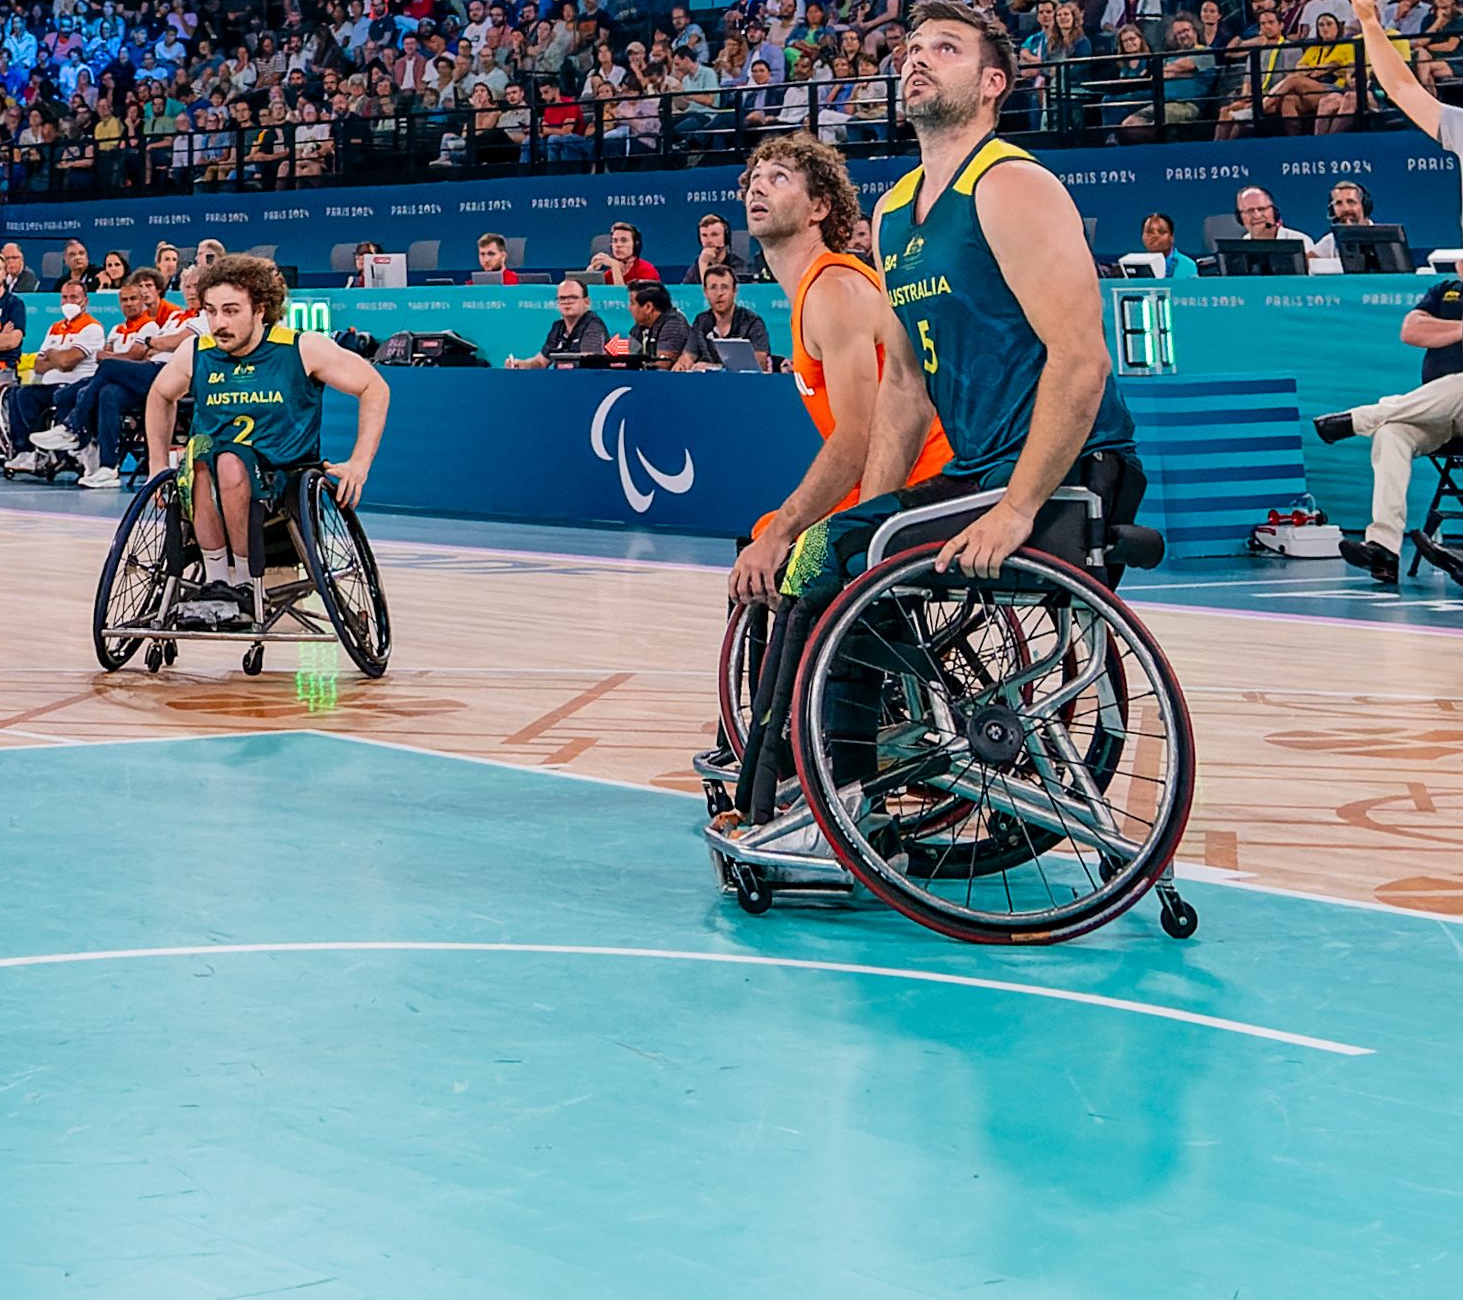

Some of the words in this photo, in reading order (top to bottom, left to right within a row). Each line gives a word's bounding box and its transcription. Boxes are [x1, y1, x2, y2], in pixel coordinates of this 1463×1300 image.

[1282, 161, 1326, 176] PARIS
[1330, 160, 1372, 175] 2024
[1407, 157, 1455, 172] PARIS
[1059, 172, 1097, 186] PARIS
[1100, 170, 1136, 184] 2024
[1166, 167, 1206, 181] PARIS
[1210, 165, 1249, 180] 2024
[531, 198, 559, 210] PARIS
[561, 197, 587, 209] 2024
[607, 195, 636, 207] PARIS
[638, 194, 666, 206] 2024
[687, 191, 717, 203] PARIS
[390, 205, 416, 216] PARIS
[417, 203, 442, 215] 2024
[459, 201, 486, 213] PARIS
[488, 199, 512, 211] 2024
[917, 319, 939, 375] 5
[206, 390, 284, 406] AUSTRALIA
[232, 415, 256, 446] 2
